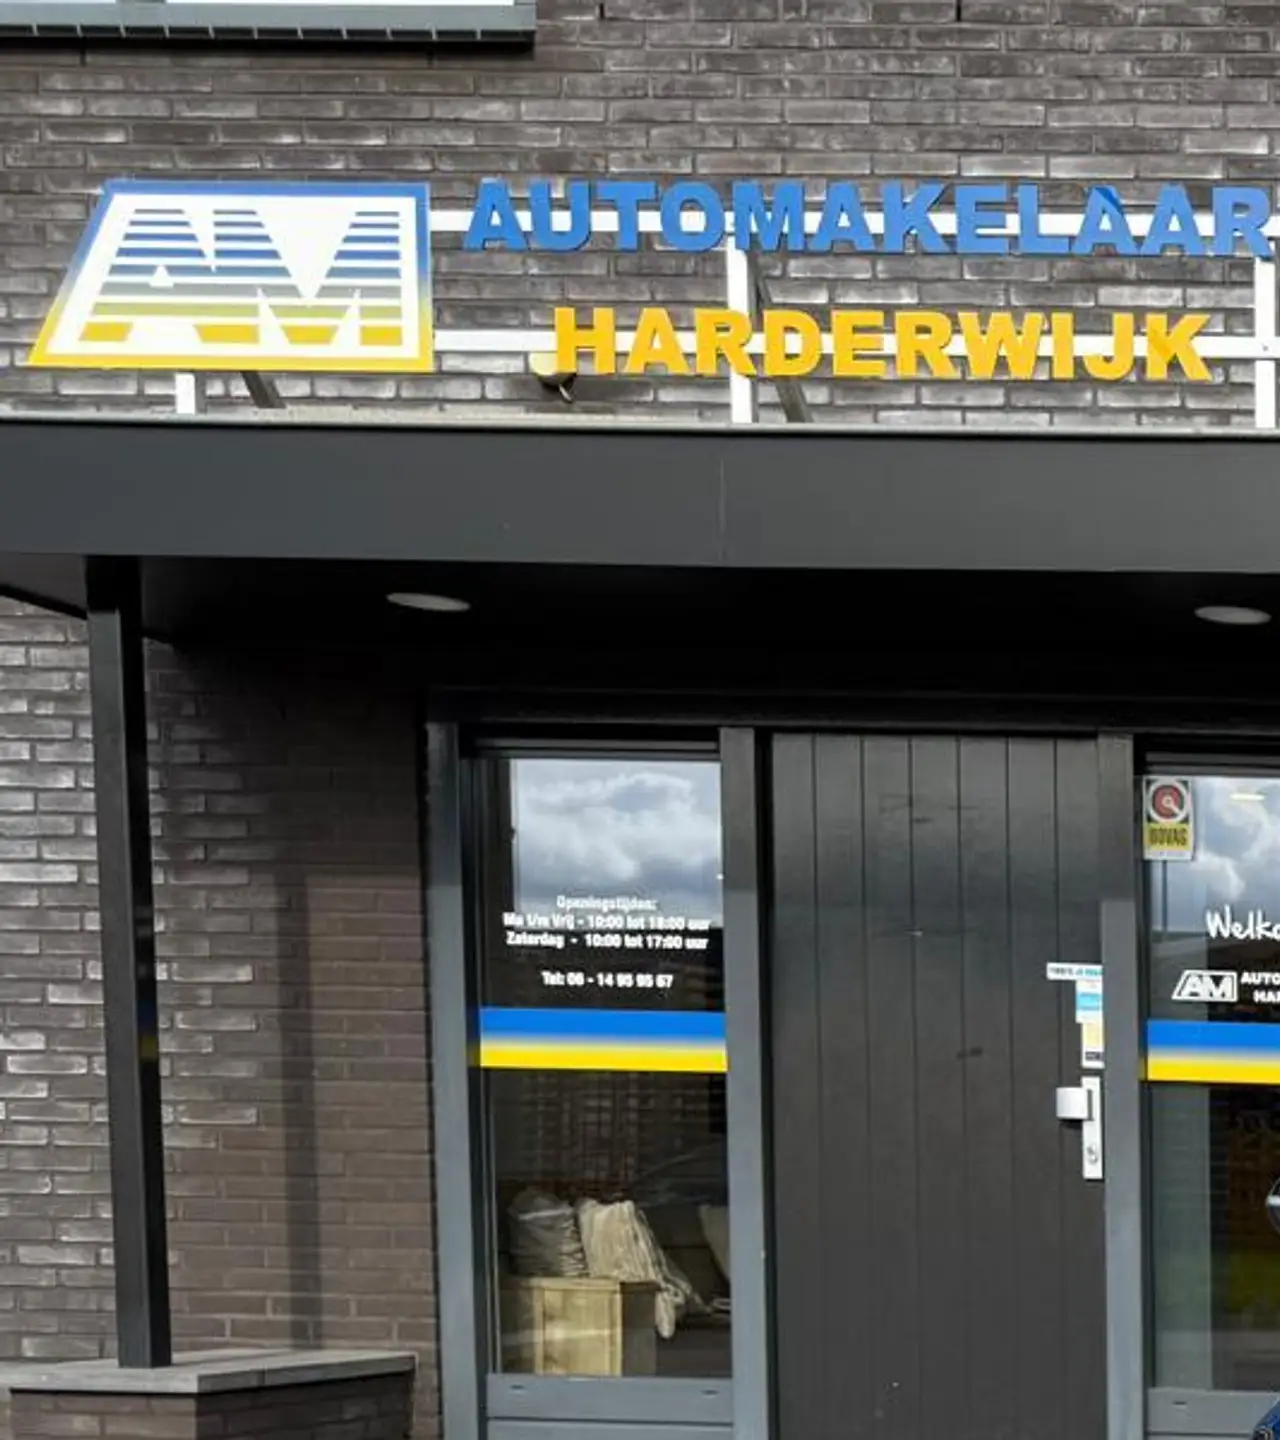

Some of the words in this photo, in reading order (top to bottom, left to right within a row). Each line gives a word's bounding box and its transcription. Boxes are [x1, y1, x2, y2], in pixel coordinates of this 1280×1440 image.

[462, 177, 1273, 260] AUTOMAKELAAR
[79, 207, 402, 347] AM
[554, 306, 1212, 381] HARDERWIJK
[506, 930, 565, 949] Zaterdag
[624, 933, 644, 949] tot
[685, 938, 709, 950] uur
[626, 914, 645, 930] tot
[688, 918, 712, 931] uur
